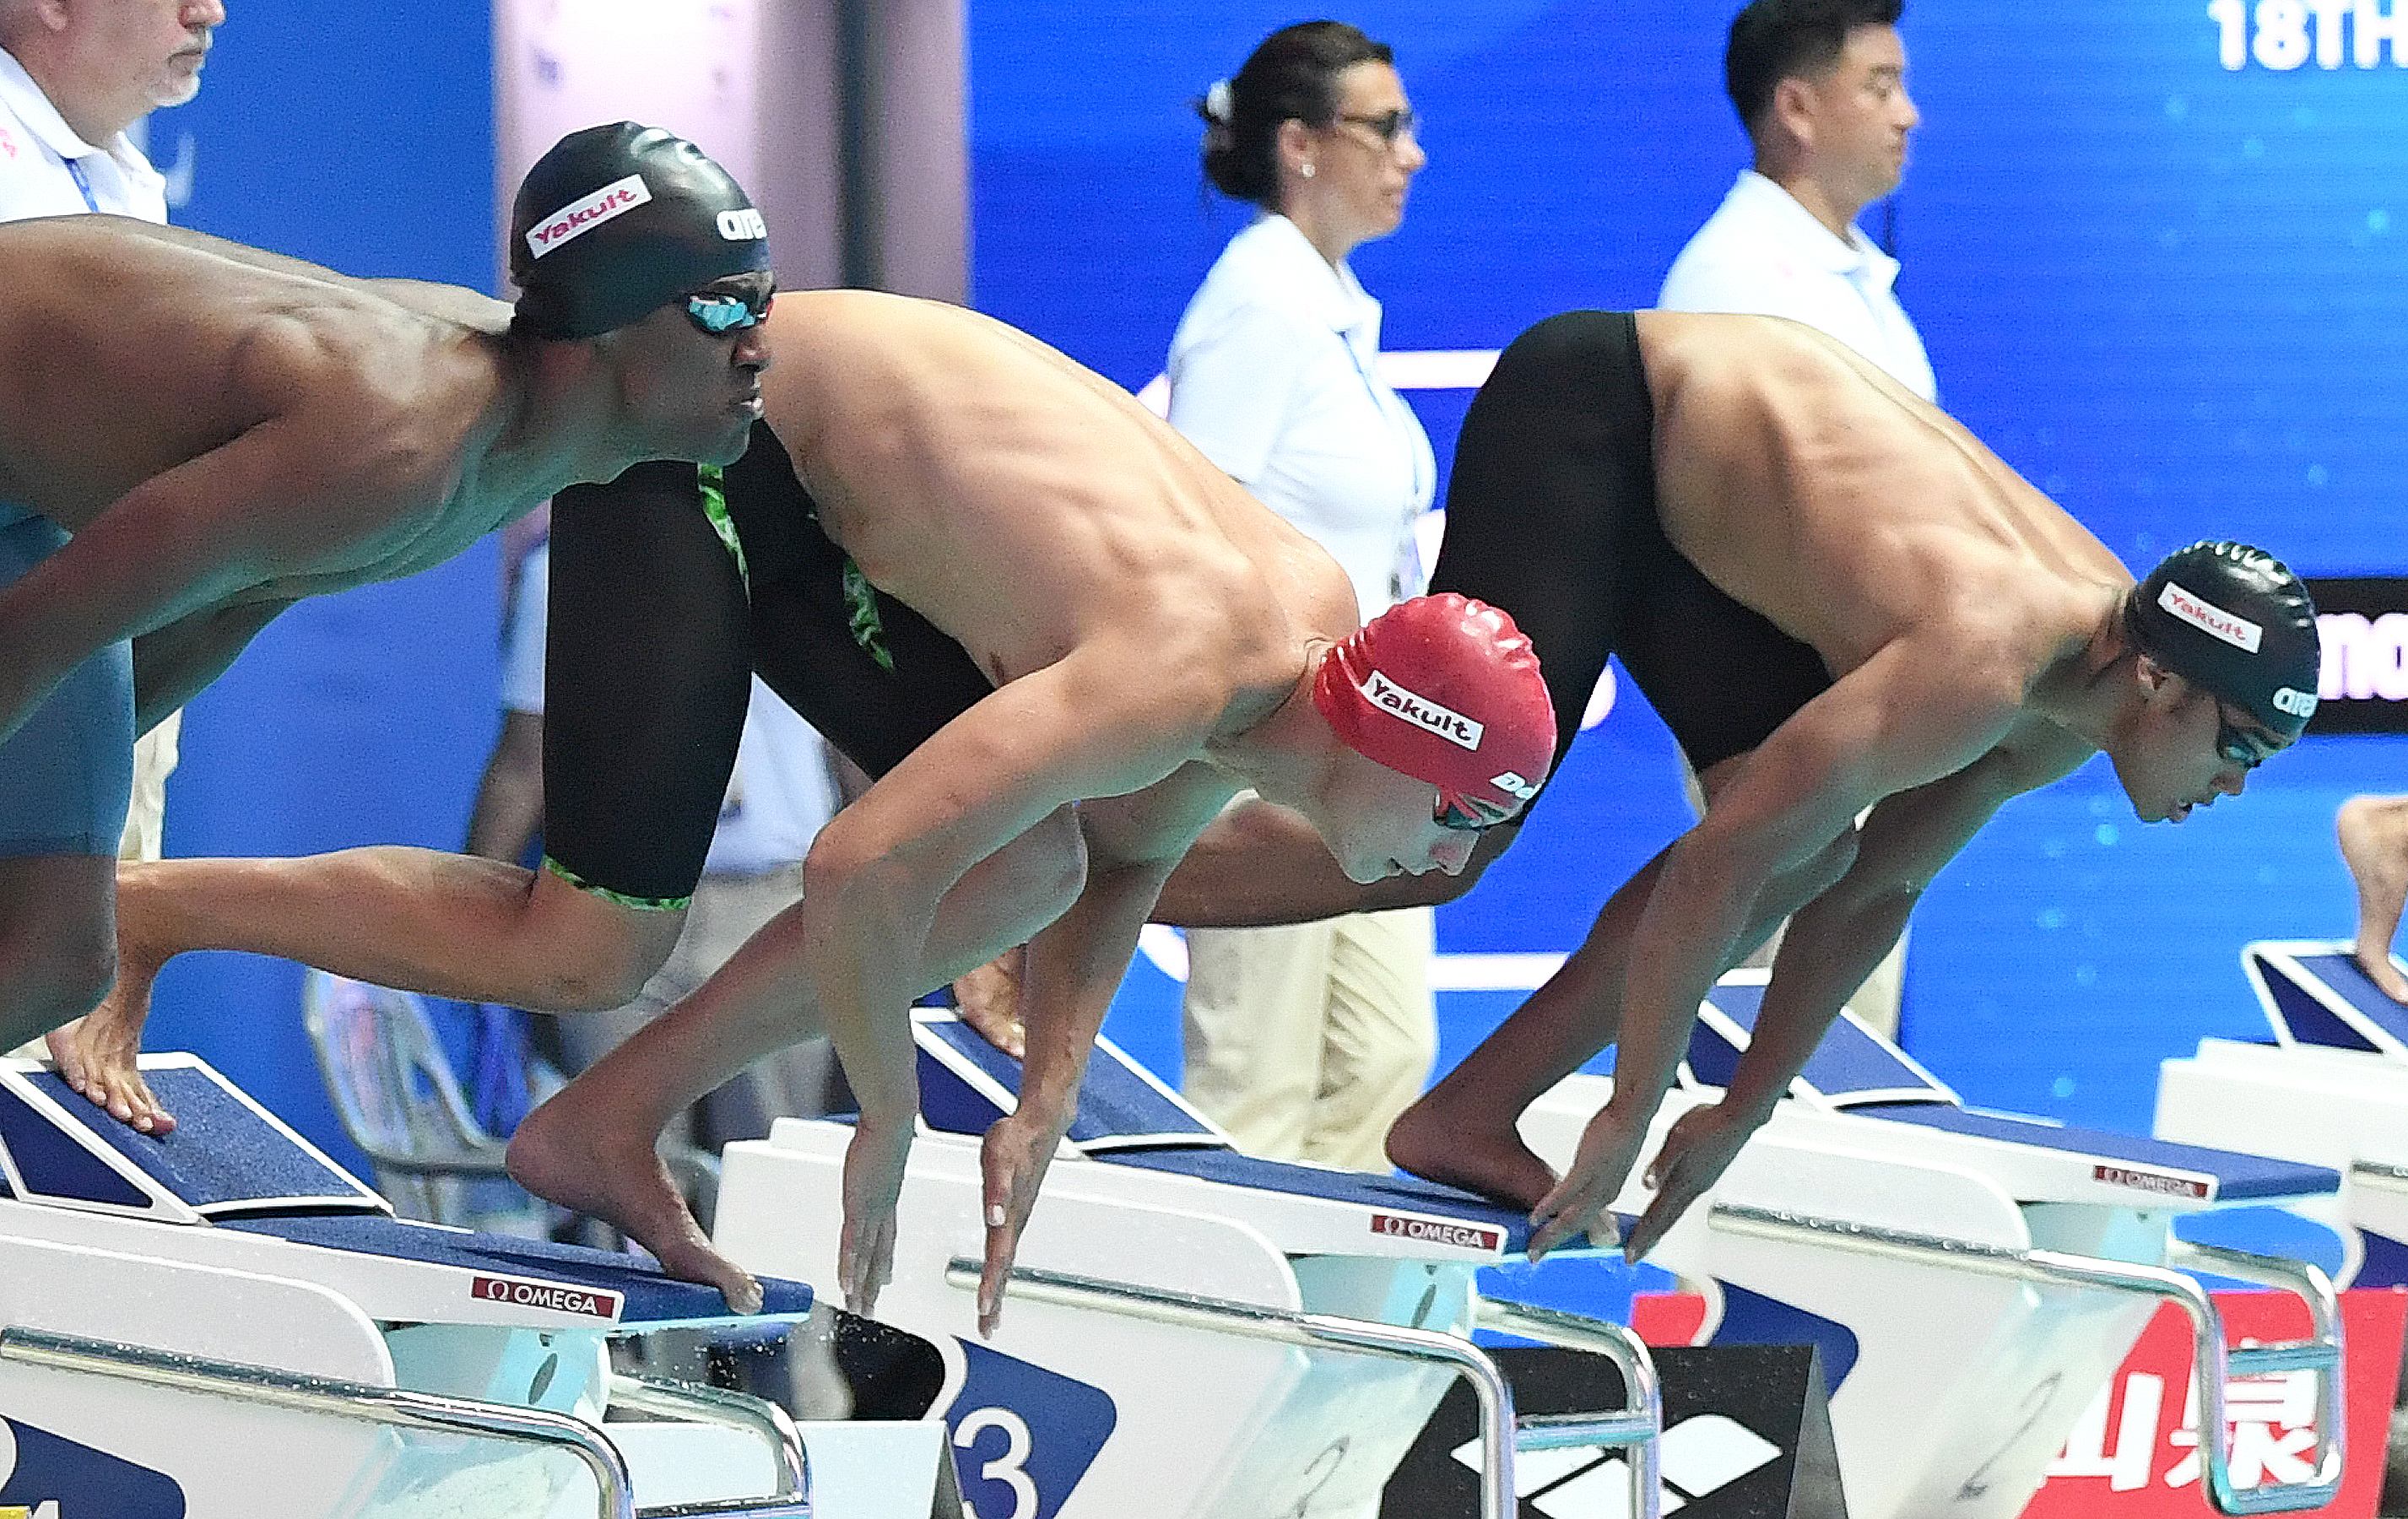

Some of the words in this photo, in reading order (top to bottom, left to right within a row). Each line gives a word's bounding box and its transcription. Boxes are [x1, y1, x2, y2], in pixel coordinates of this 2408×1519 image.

[2206, 0, 2408, 71] 18TH
[535, 188, 637, 245] Yakult
[2171, 592, 2246, 641] Yakult
[1372, 678, 1471, 742] Yakult
[2126, 1170, 2194, 1197] OMEGA
[1408, 1221, 1483, 1248] OMEGA
[515, 1285, 598, 1315] OMEGA
[954, 1408, 1038, 1519] 3
